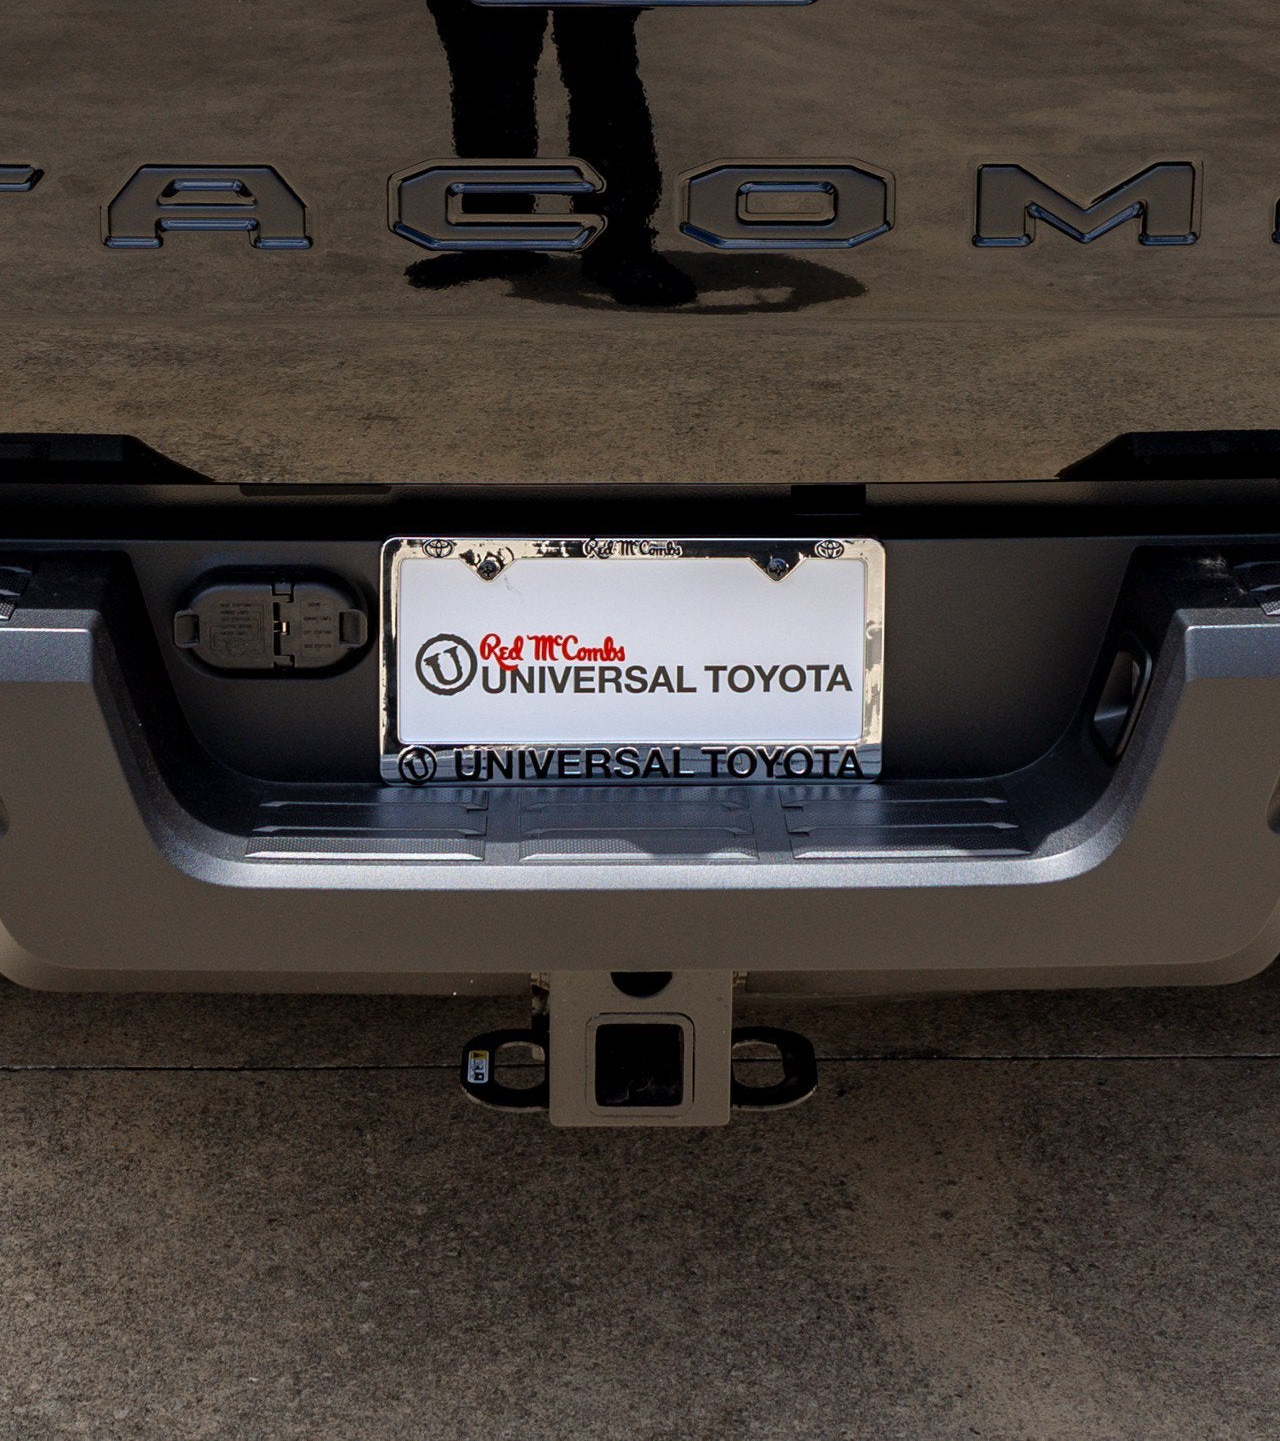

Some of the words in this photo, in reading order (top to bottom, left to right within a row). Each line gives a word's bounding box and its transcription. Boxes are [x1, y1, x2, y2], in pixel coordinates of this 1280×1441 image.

[583, 538, 613, 559] Red
[615, 539, 683, 557] McCombs
[480, 633, 523, 672] Red
[527, 634, 626, 663] McCombs
[482, 664, 697, 695] UNIVERSAL
[704, 664, 853, 694] TOYOTA
[453, 746, 696, 781] UNIVERSAL
[702, 746, 866, 780] TOYOTA
